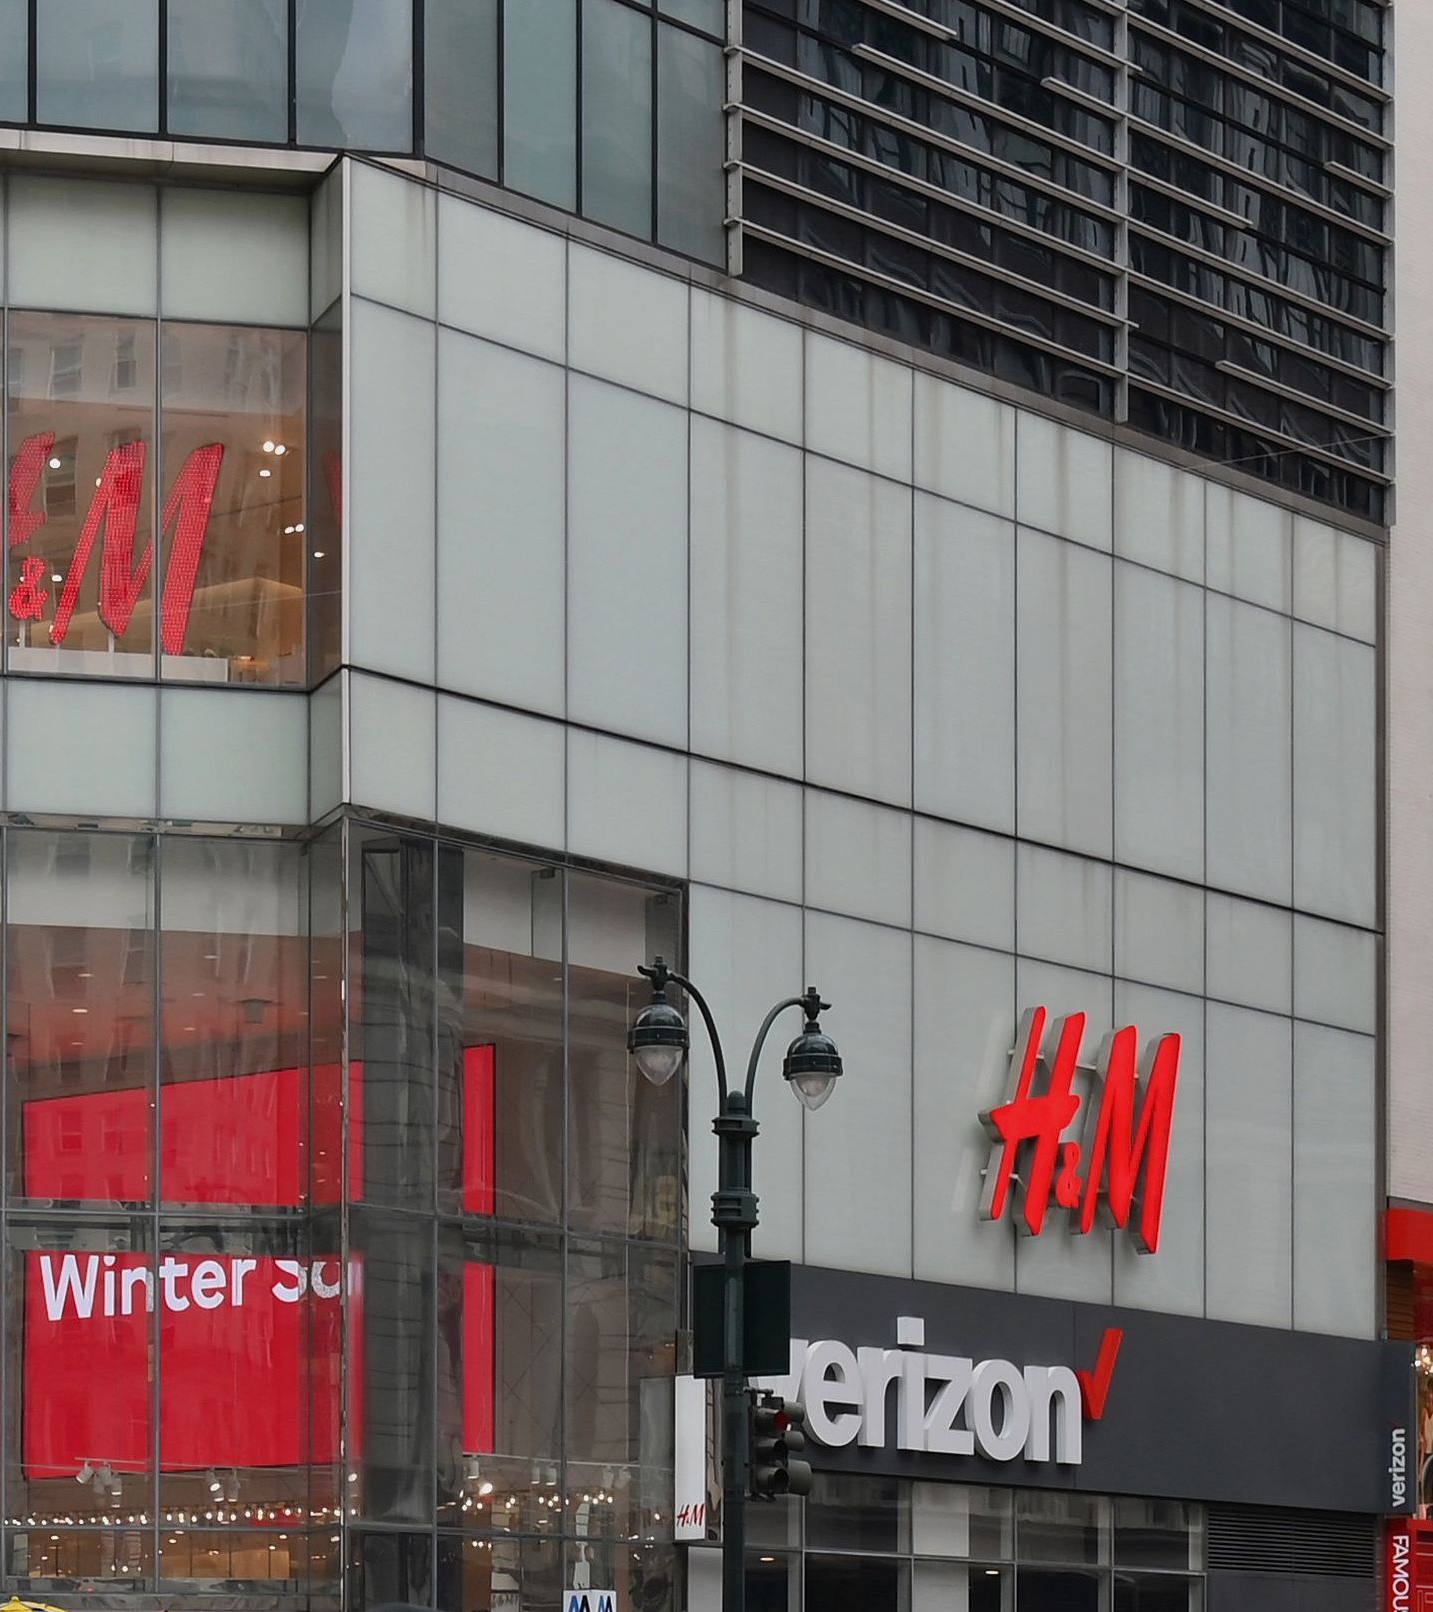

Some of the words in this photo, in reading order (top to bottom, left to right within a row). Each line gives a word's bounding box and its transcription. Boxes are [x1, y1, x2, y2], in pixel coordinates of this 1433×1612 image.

[978, 1005, 1181, 1256] H&M
[39, 1254, 256, 1322] Winter
[1388, 1428, 1406, 1507] verizon
